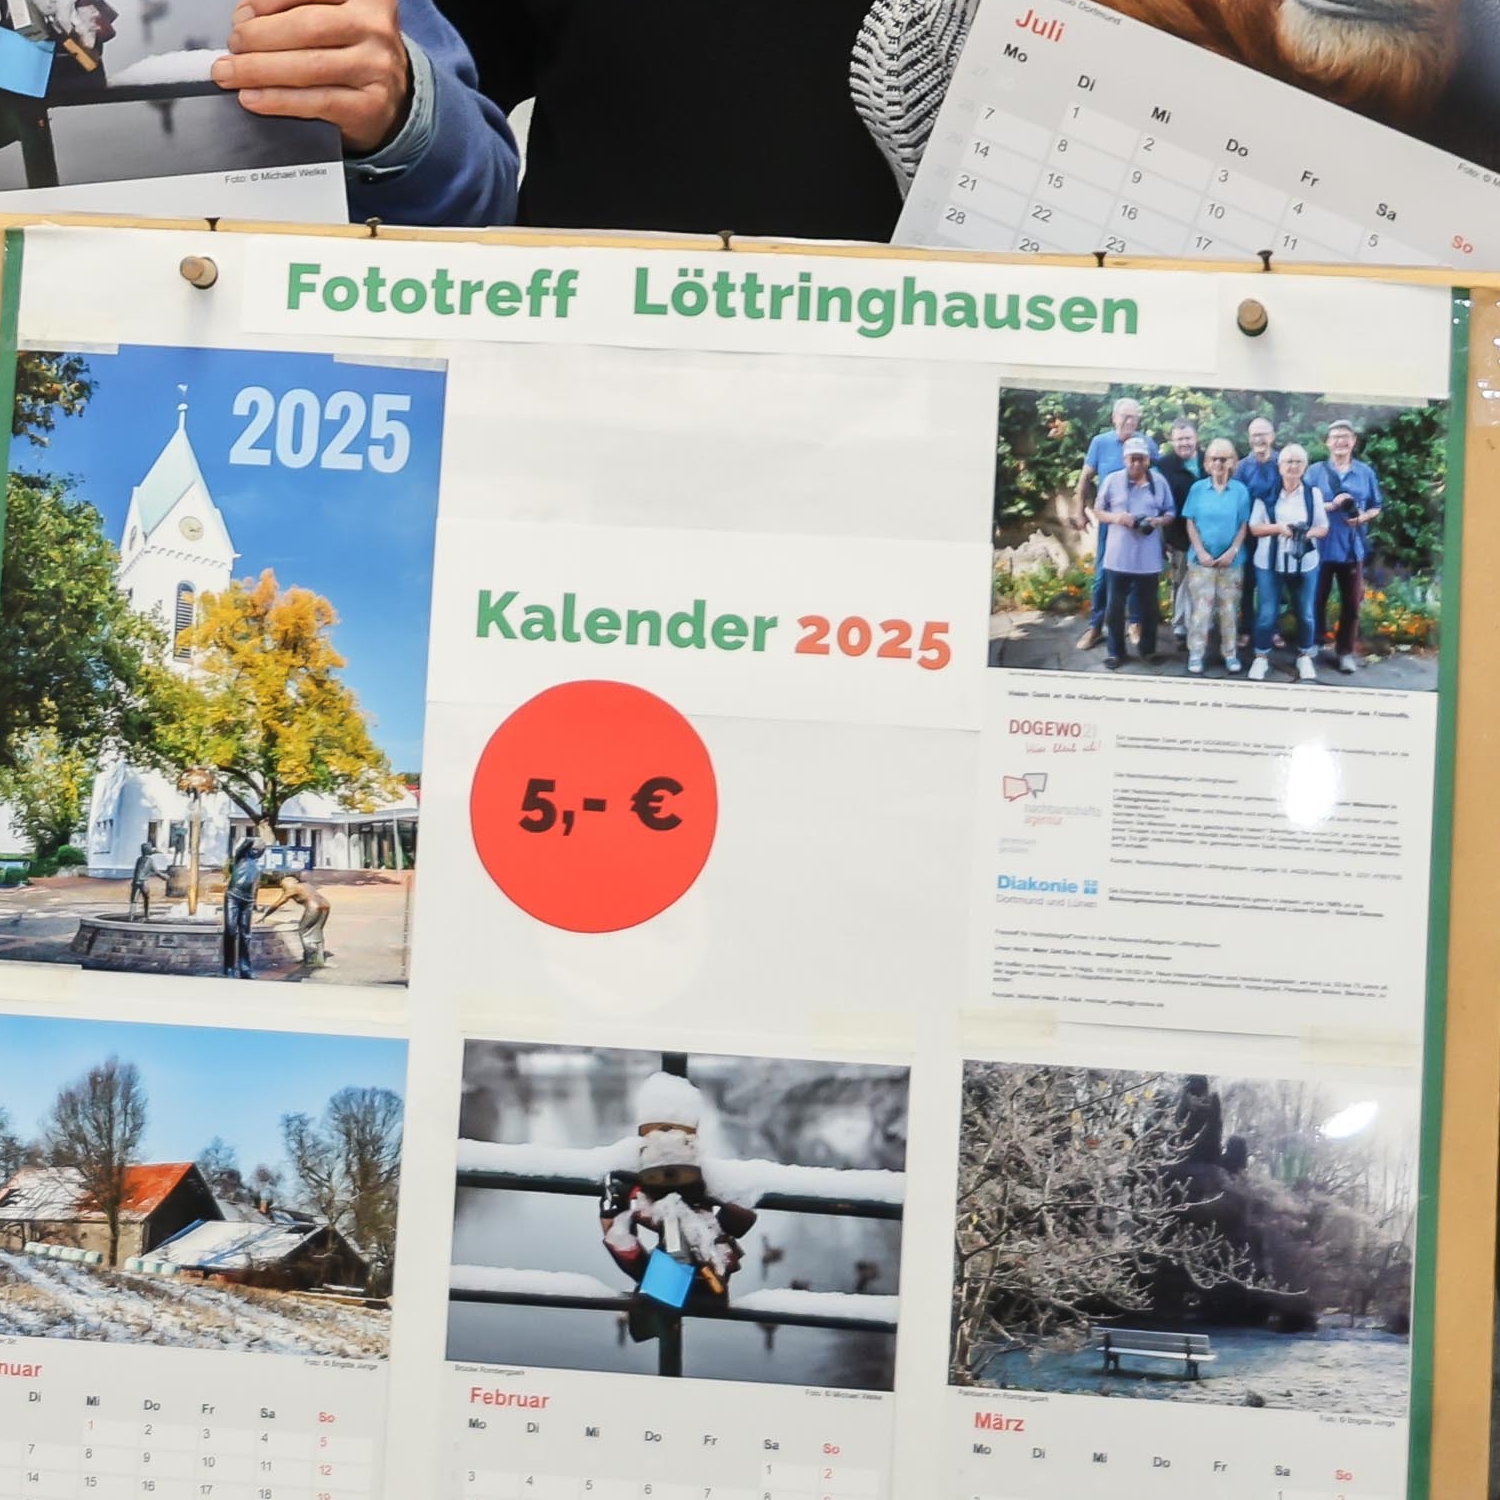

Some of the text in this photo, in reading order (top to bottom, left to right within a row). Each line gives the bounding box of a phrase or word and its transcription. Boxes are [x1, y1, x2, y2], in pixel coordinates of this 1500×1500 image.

[1016, 10, 1064, 42] Juli
[1004, 44, 1473, 254] Mo Di Mi Do Fr Sa So
[261, 170, 297, 180] Michael
[975, 142, 1212, 250] 14 15 16 17
[985, 108, 1297, 250] 7 8 9 10 11
[1073, 107, 1379, 247] 1 2 3 4 5
[946, 208, 966, 224] 28
[958, 175, 1127, 253] 21 22 23
[287, 263, 1138, 338] Fototreff Löttringhausen
[229, 386, 411, 473] 2025
[476, 590, 951, 671] Kalender 2025
[518, 776, 684, 836] 5,- €
[997, 874, 1078, 893] Diakonie
[29, 1392, 41, 1402] Di
[86, 1396, 100, 1406] Mi
[144, 1400, 160, 1410] Do
[202, 1404, 215, 1414] Fr
[260, 1408, 275, 1419] Sa
[319, 1412, 335, 1423] So
[471, 1387, 549, 1408] Februar
[469, 1418, 840, 1454] Mo Di Mi Do Fr Sa So
[975, 1412, 1024, 1432] März
[973, 1444, 1353, 1481] Mo Di Mi Do Fr Sa So
